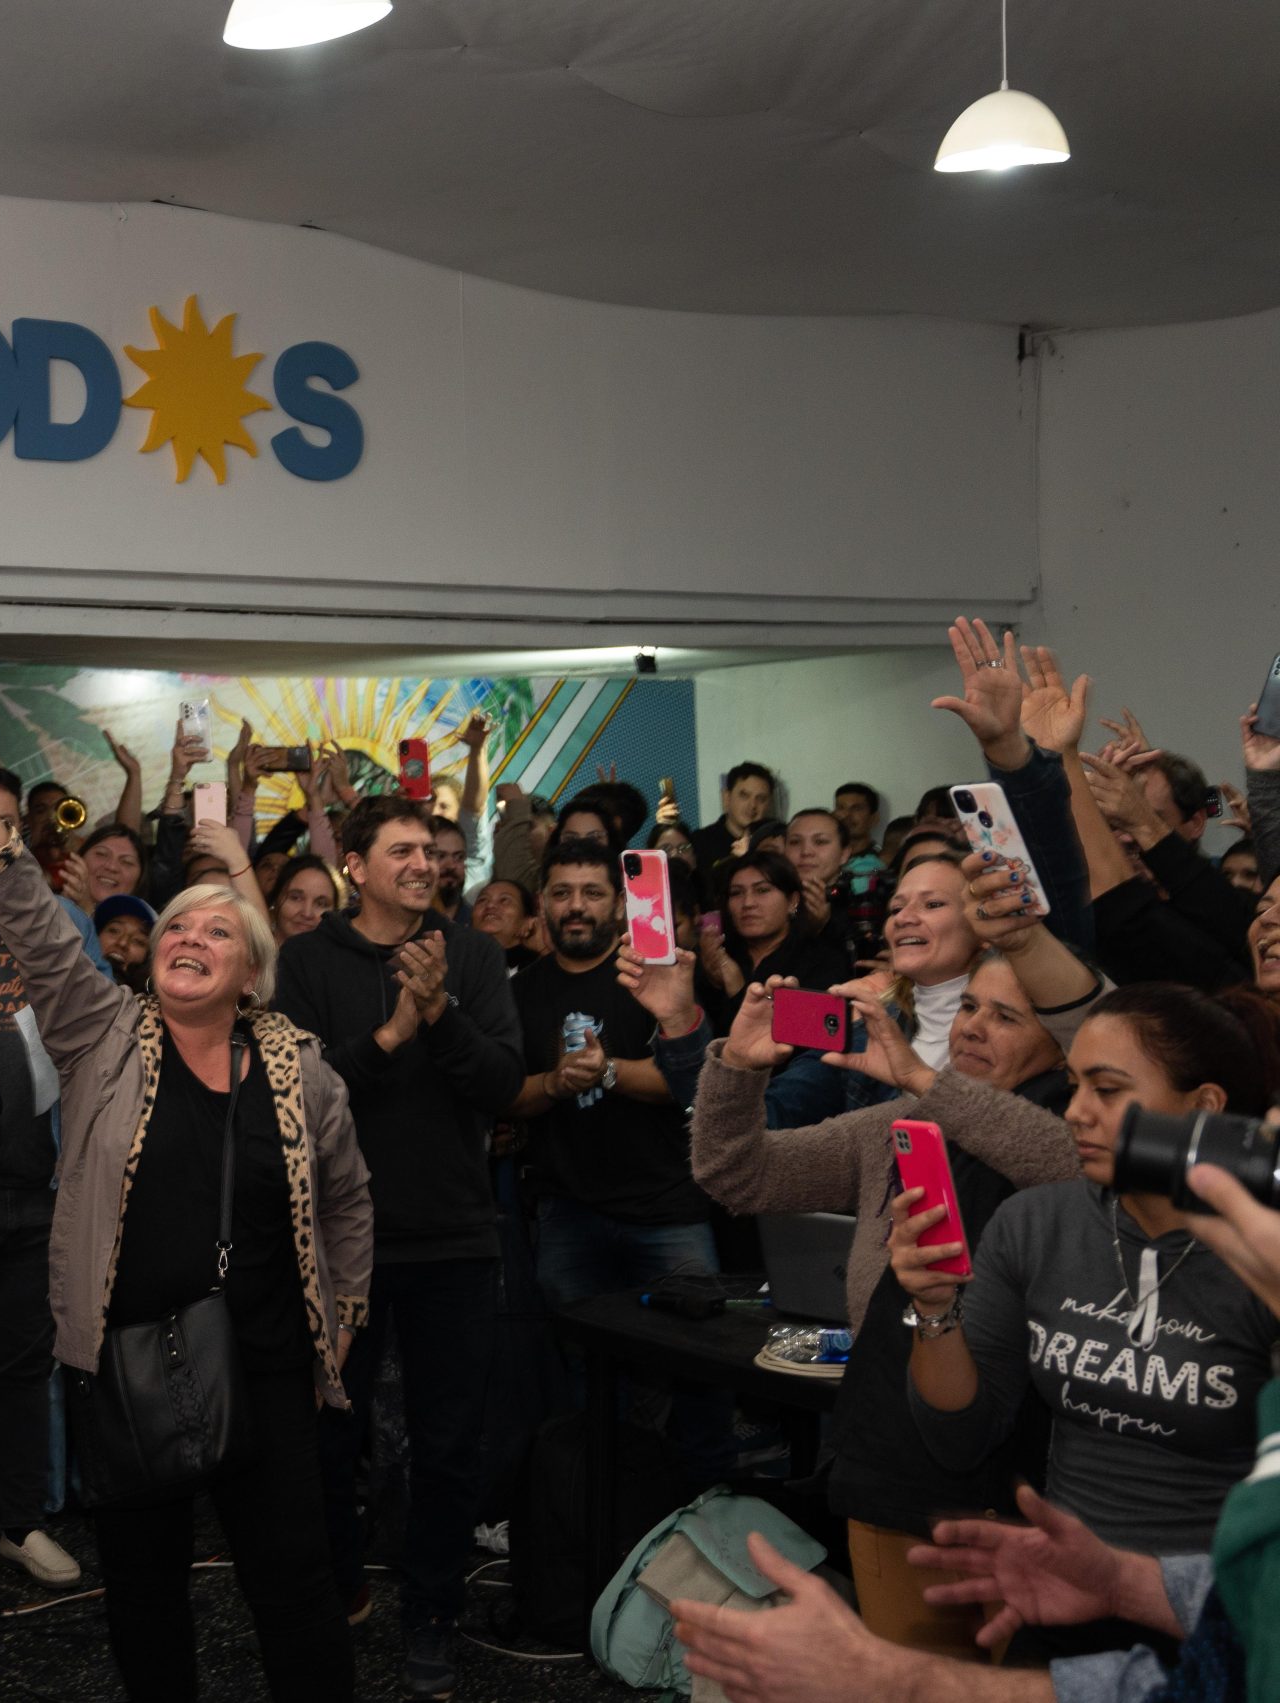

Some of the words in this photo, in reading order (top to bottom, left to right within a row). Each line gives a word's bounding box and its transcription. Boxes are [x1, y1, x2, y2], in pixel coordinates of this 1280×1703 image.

[1059, 1287, 1132, 1324] make
[1027, 1319, 1238, 1409] DREAMS
[1061, 1381, 1177, 1436] happen
